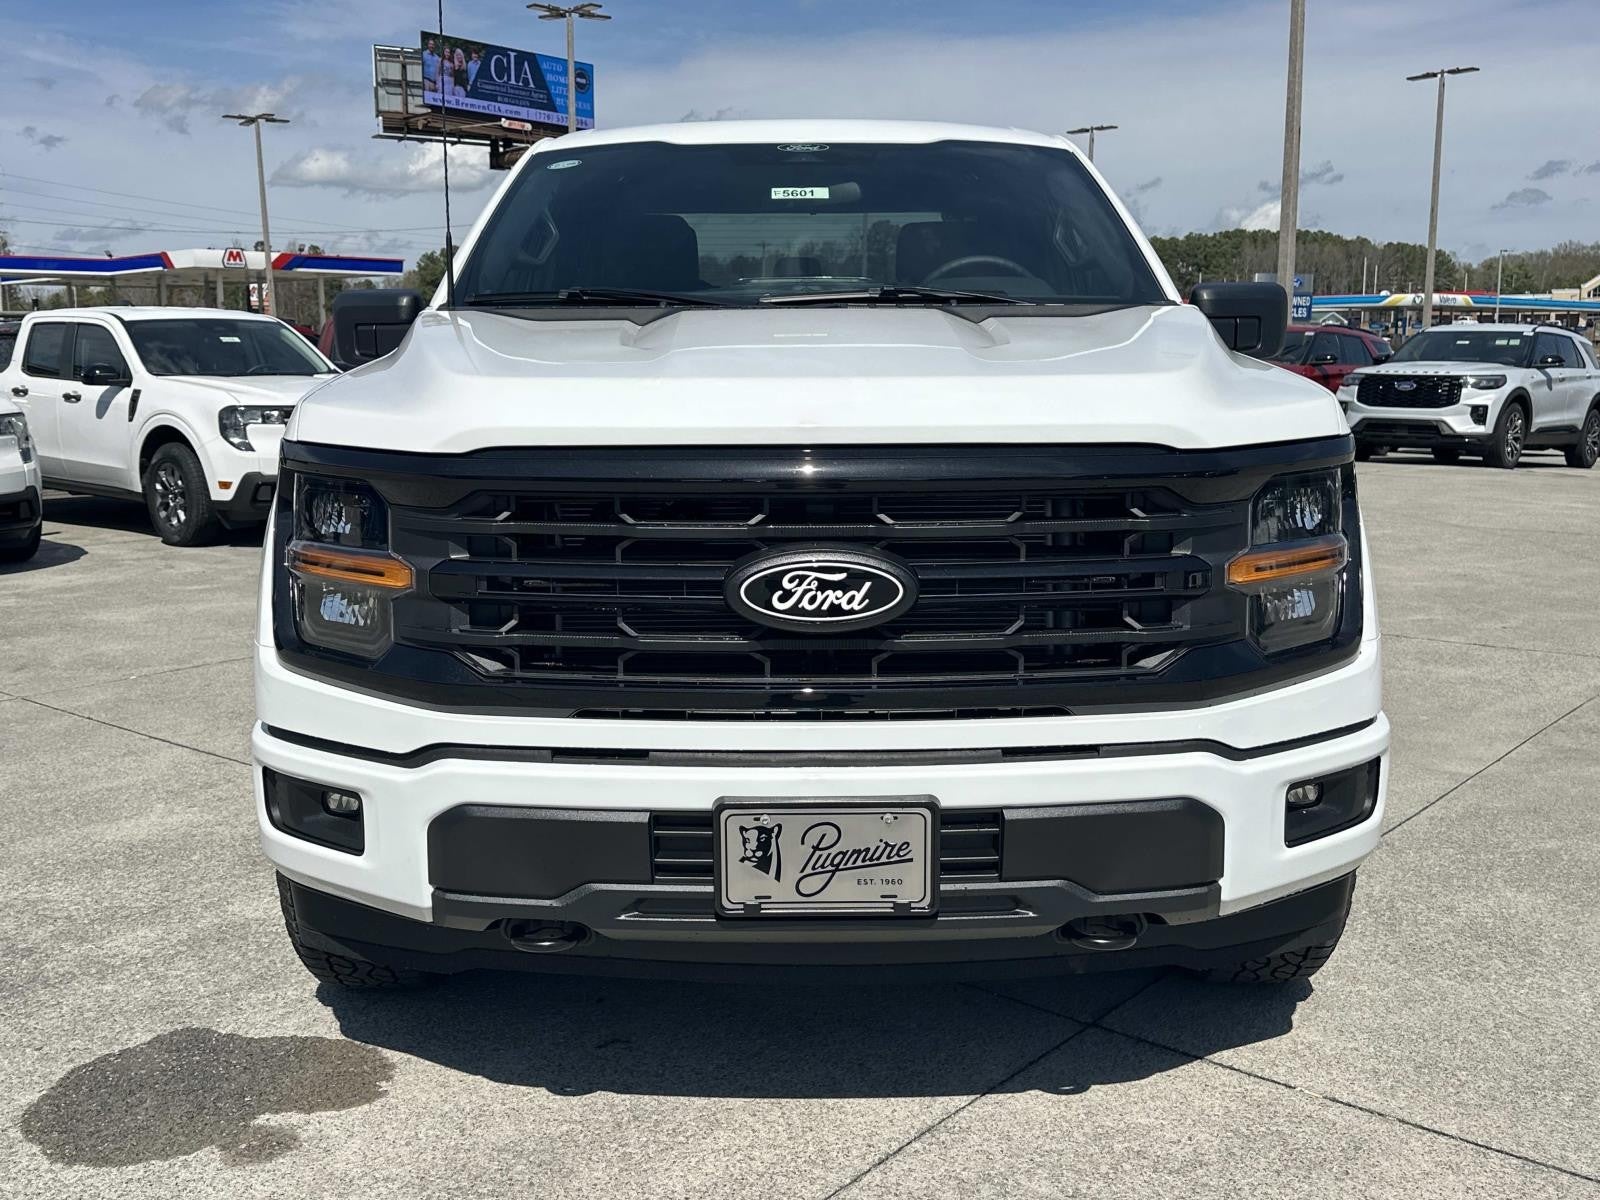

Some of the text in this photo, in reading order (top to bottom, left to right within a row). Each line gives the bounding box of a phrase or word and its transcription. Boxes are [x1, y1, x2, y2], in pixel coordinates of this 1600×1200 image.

[490, 51, 536, 88] CIA
[543, 61, 563, 72] AUTO
[226, 250, 243, 262] M
[1292, 296, 1311, 306] WNED
[1440, 295, 1457, 305] Valero
[772, 570, 872, 611] Ford
[795, 821, 914, 898] Pugmire
[857, 878, 903, 886] EST. 1960
